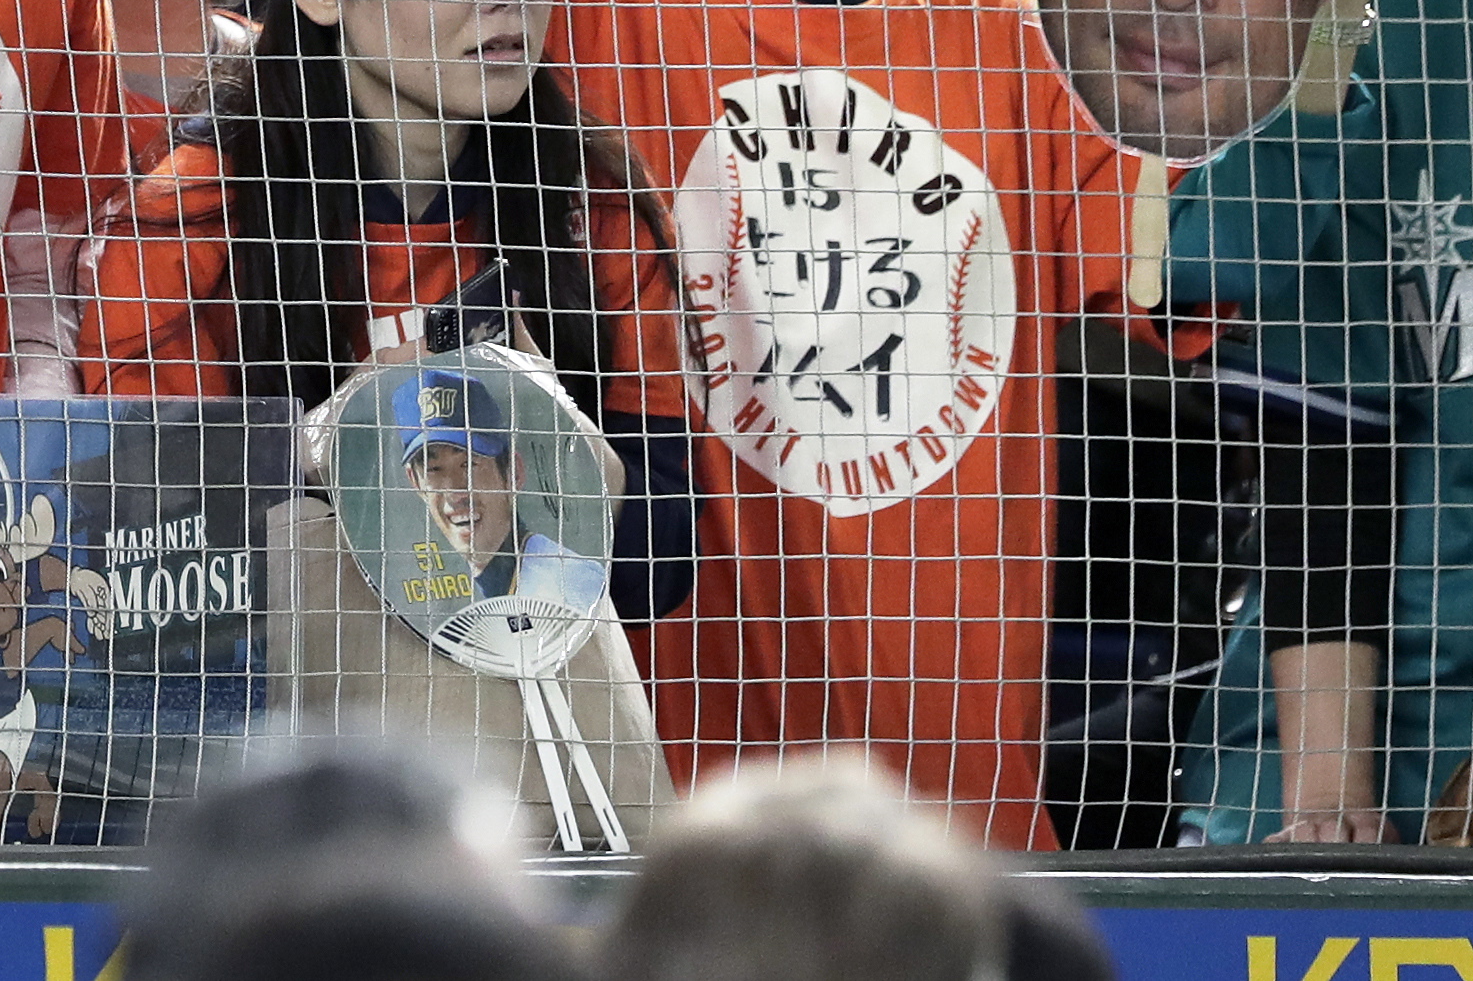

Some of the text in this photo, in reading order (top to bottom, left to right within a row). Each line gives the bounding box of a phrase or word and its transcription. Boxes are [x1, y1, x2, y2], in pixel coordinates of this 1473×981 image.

[734, 396, 802, 467] HIT
[105, 514, 208, 569] MARINER
[412, 542, 445, 572] 51
[109, 553, 253, 631] MOOSE
[403, 573, 471, 604] ICHIRO
